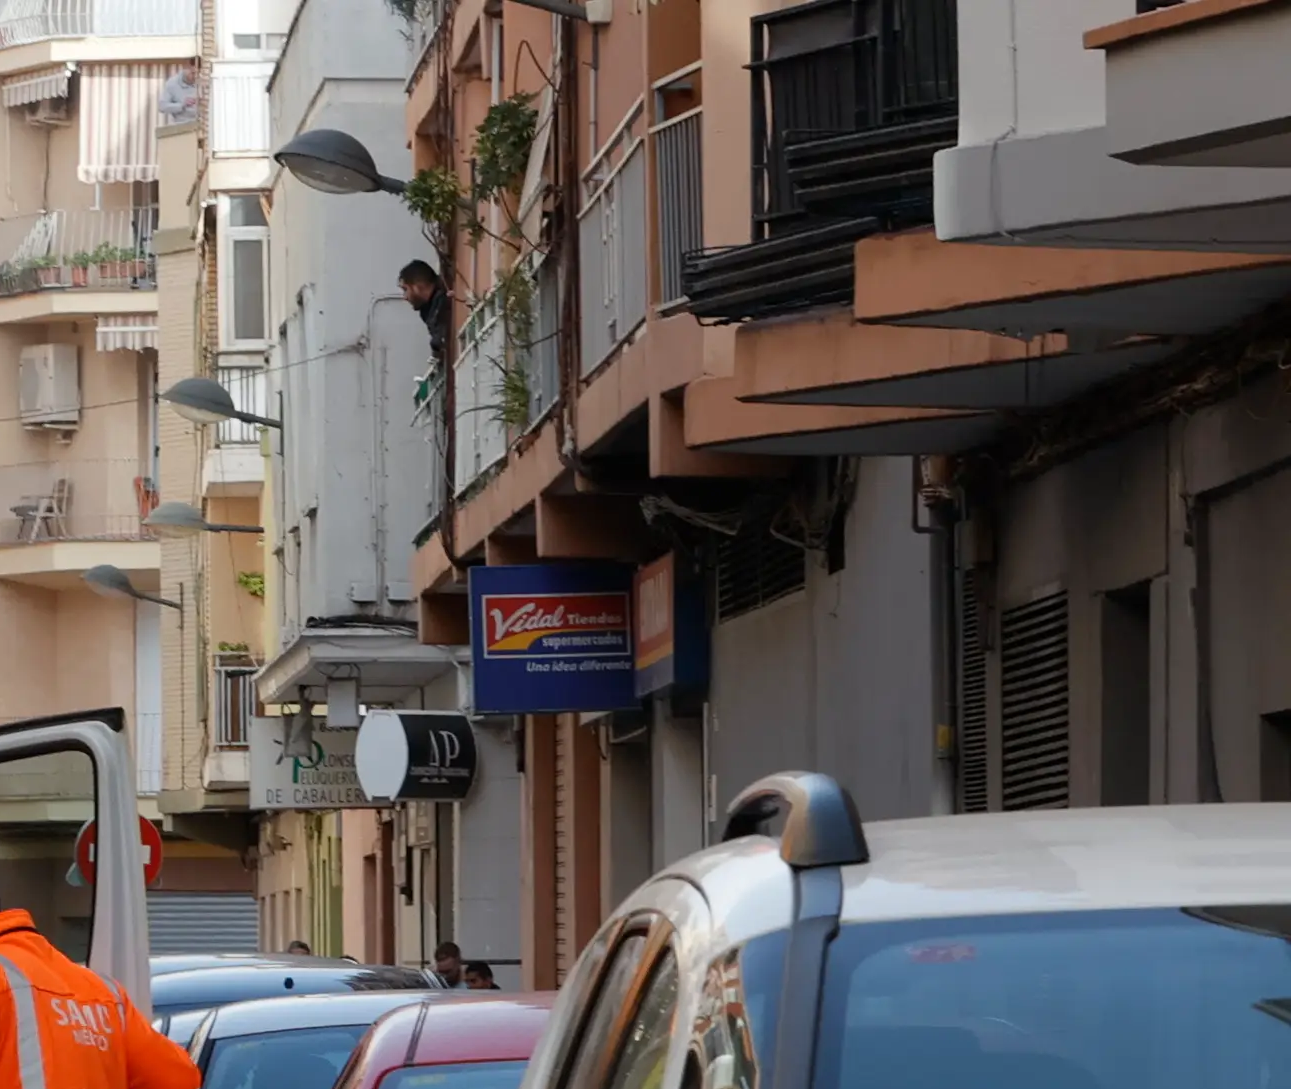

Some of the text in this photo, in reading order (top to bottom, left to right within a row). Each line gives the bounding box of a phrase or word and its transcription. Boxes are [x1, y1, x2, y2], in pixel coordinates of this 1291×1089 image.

[490, 602, 565, 640] Vidal
[567, 612, 623, 625] Tiendas
[542, 632, 623, 649] supermercados
[526, 659, 632, 672] Una idea diferente
[266, 788, 283, 805] DE
